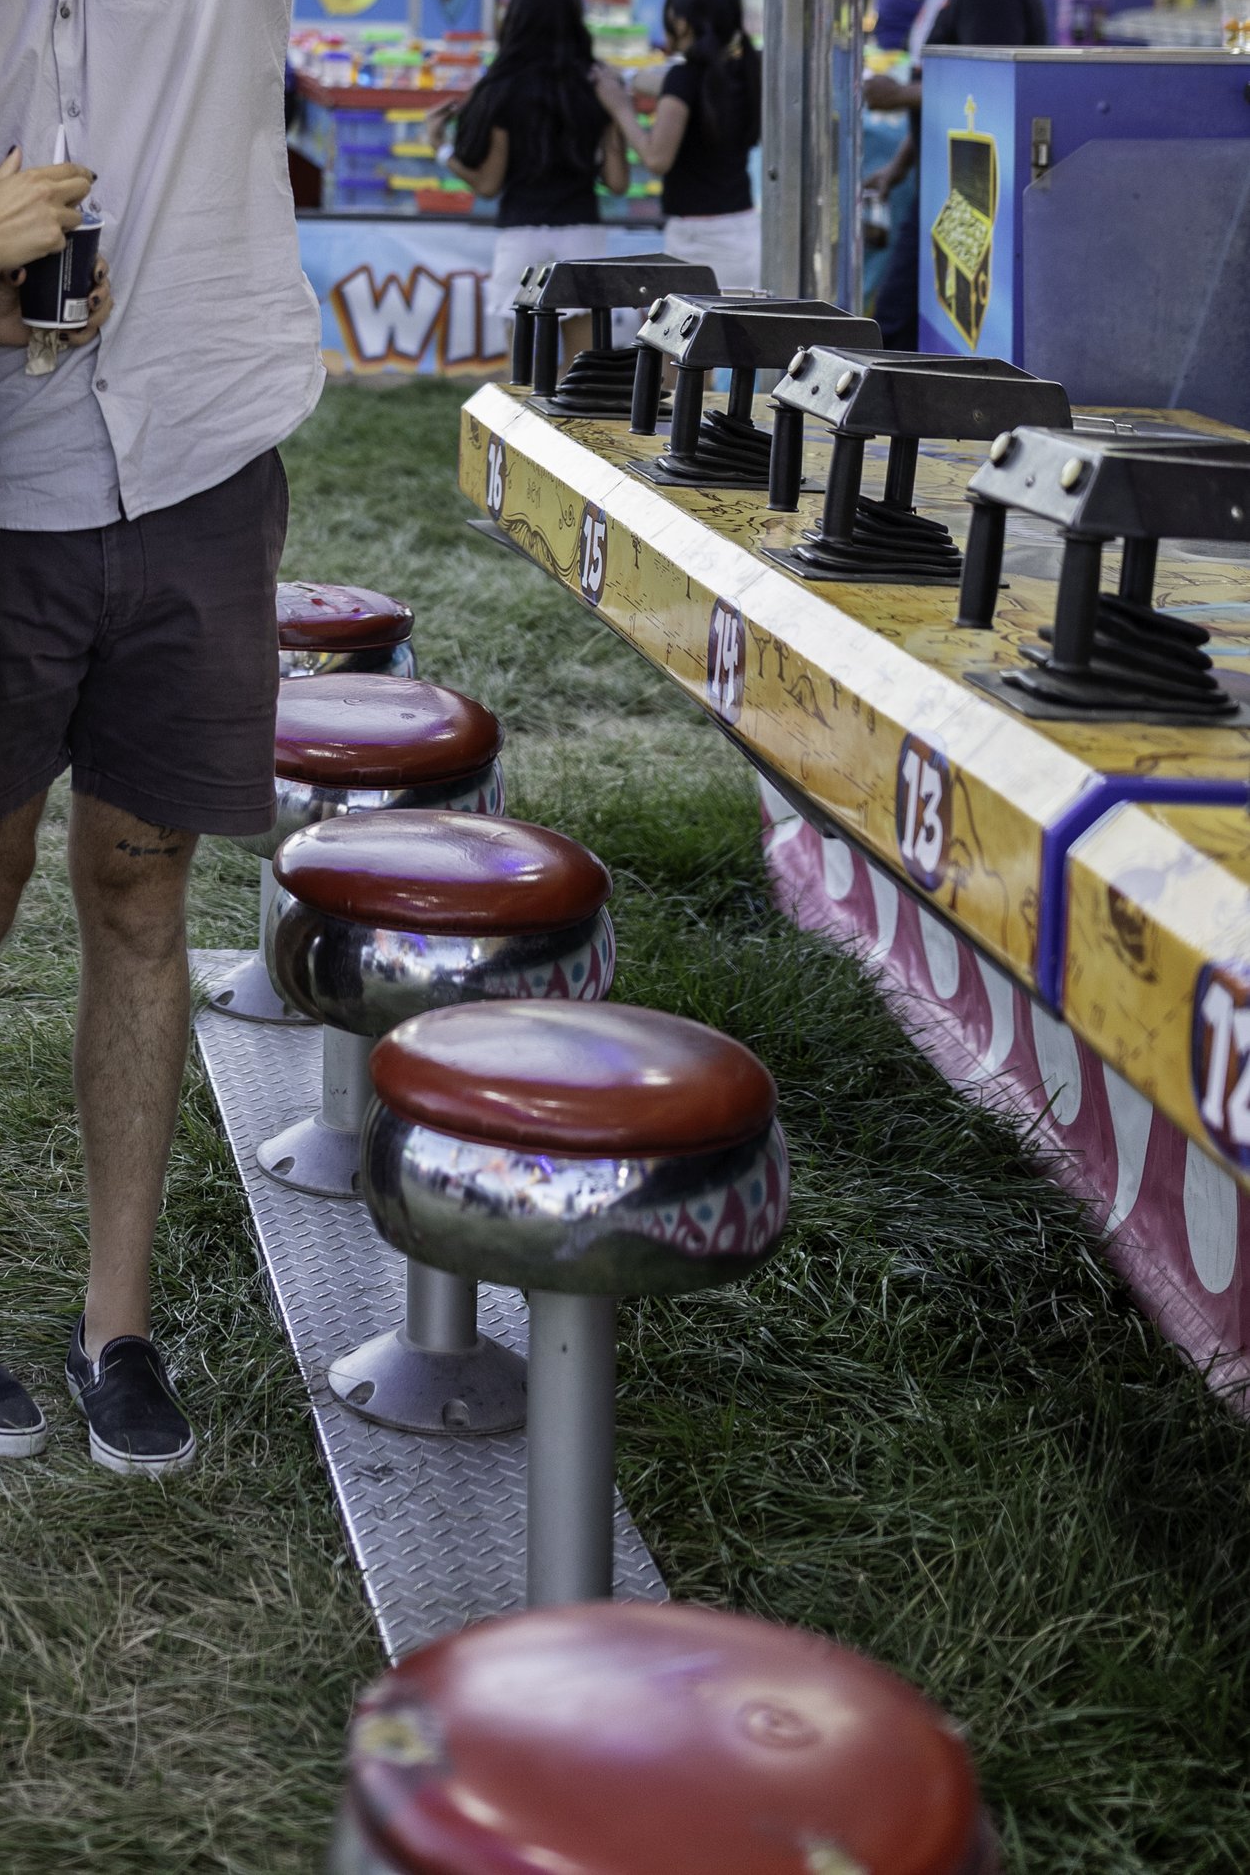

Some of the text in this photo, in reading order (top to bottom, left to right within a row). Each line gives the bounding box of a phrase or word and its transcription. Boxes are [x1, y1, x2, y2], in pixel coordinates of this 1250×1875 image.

[487, 443, 503, 511] 16
[580, 517, 606, 592] 15
[709, 606, 740, 709] 14
[901, 749, 944, 873] 13
